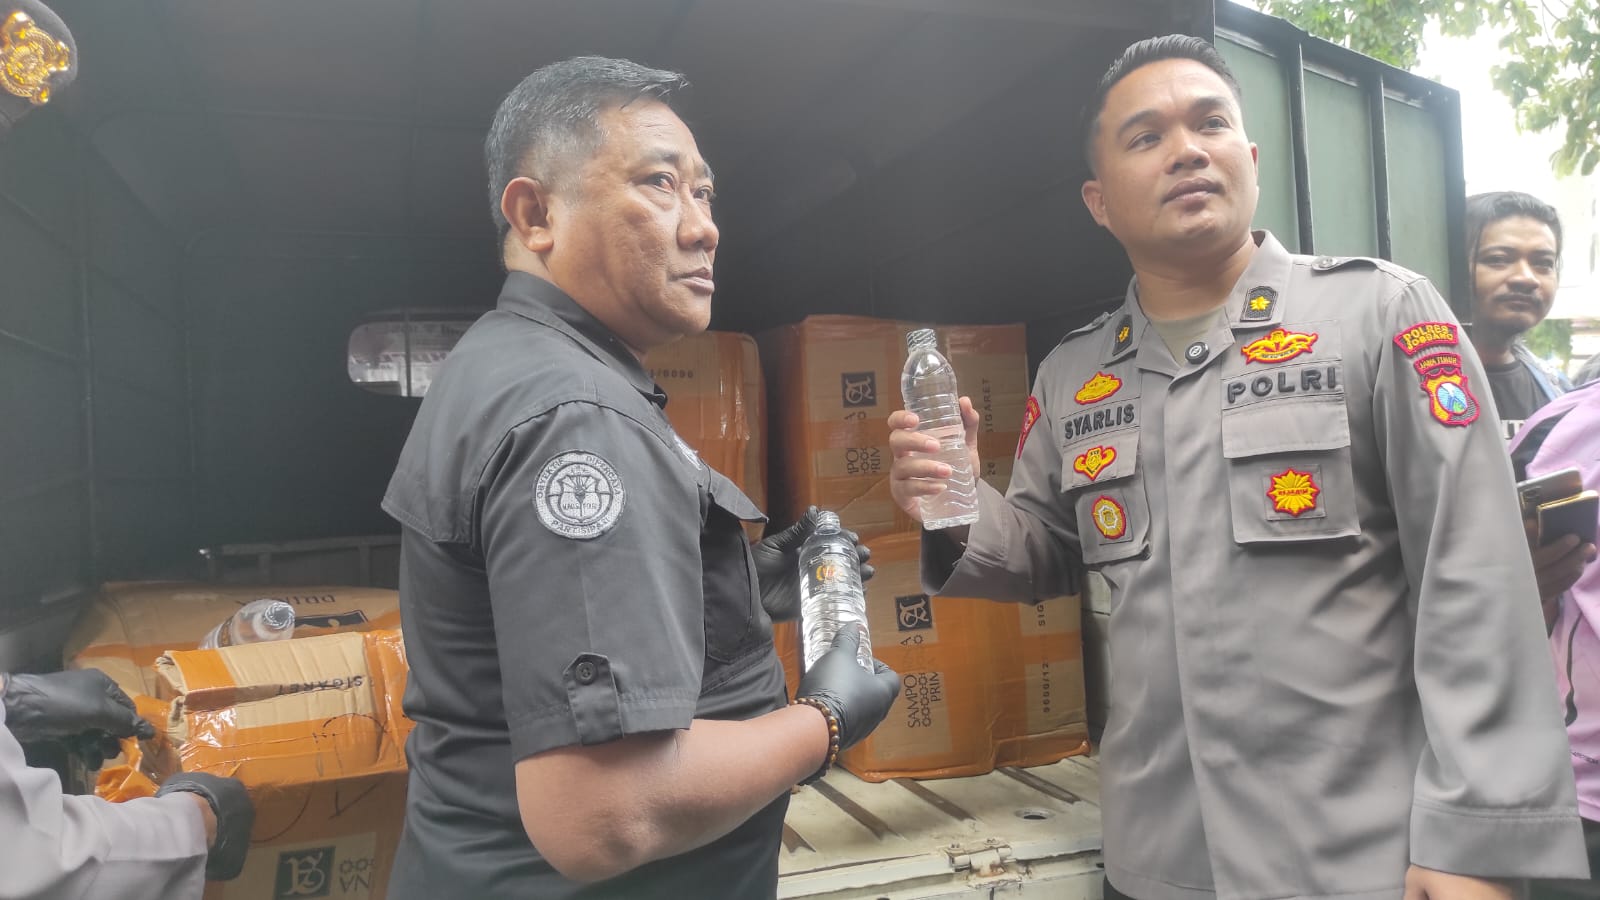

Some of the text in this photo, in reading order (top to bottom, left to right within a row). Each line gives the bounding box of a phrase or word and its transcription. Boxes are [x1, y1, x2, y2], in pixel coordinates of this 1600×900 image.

[1403, 325, 1449, 342] POLRES
[1227, 366, 1336, 404] POLRI
[1065, 403, 1135, 440] SYARLIS
